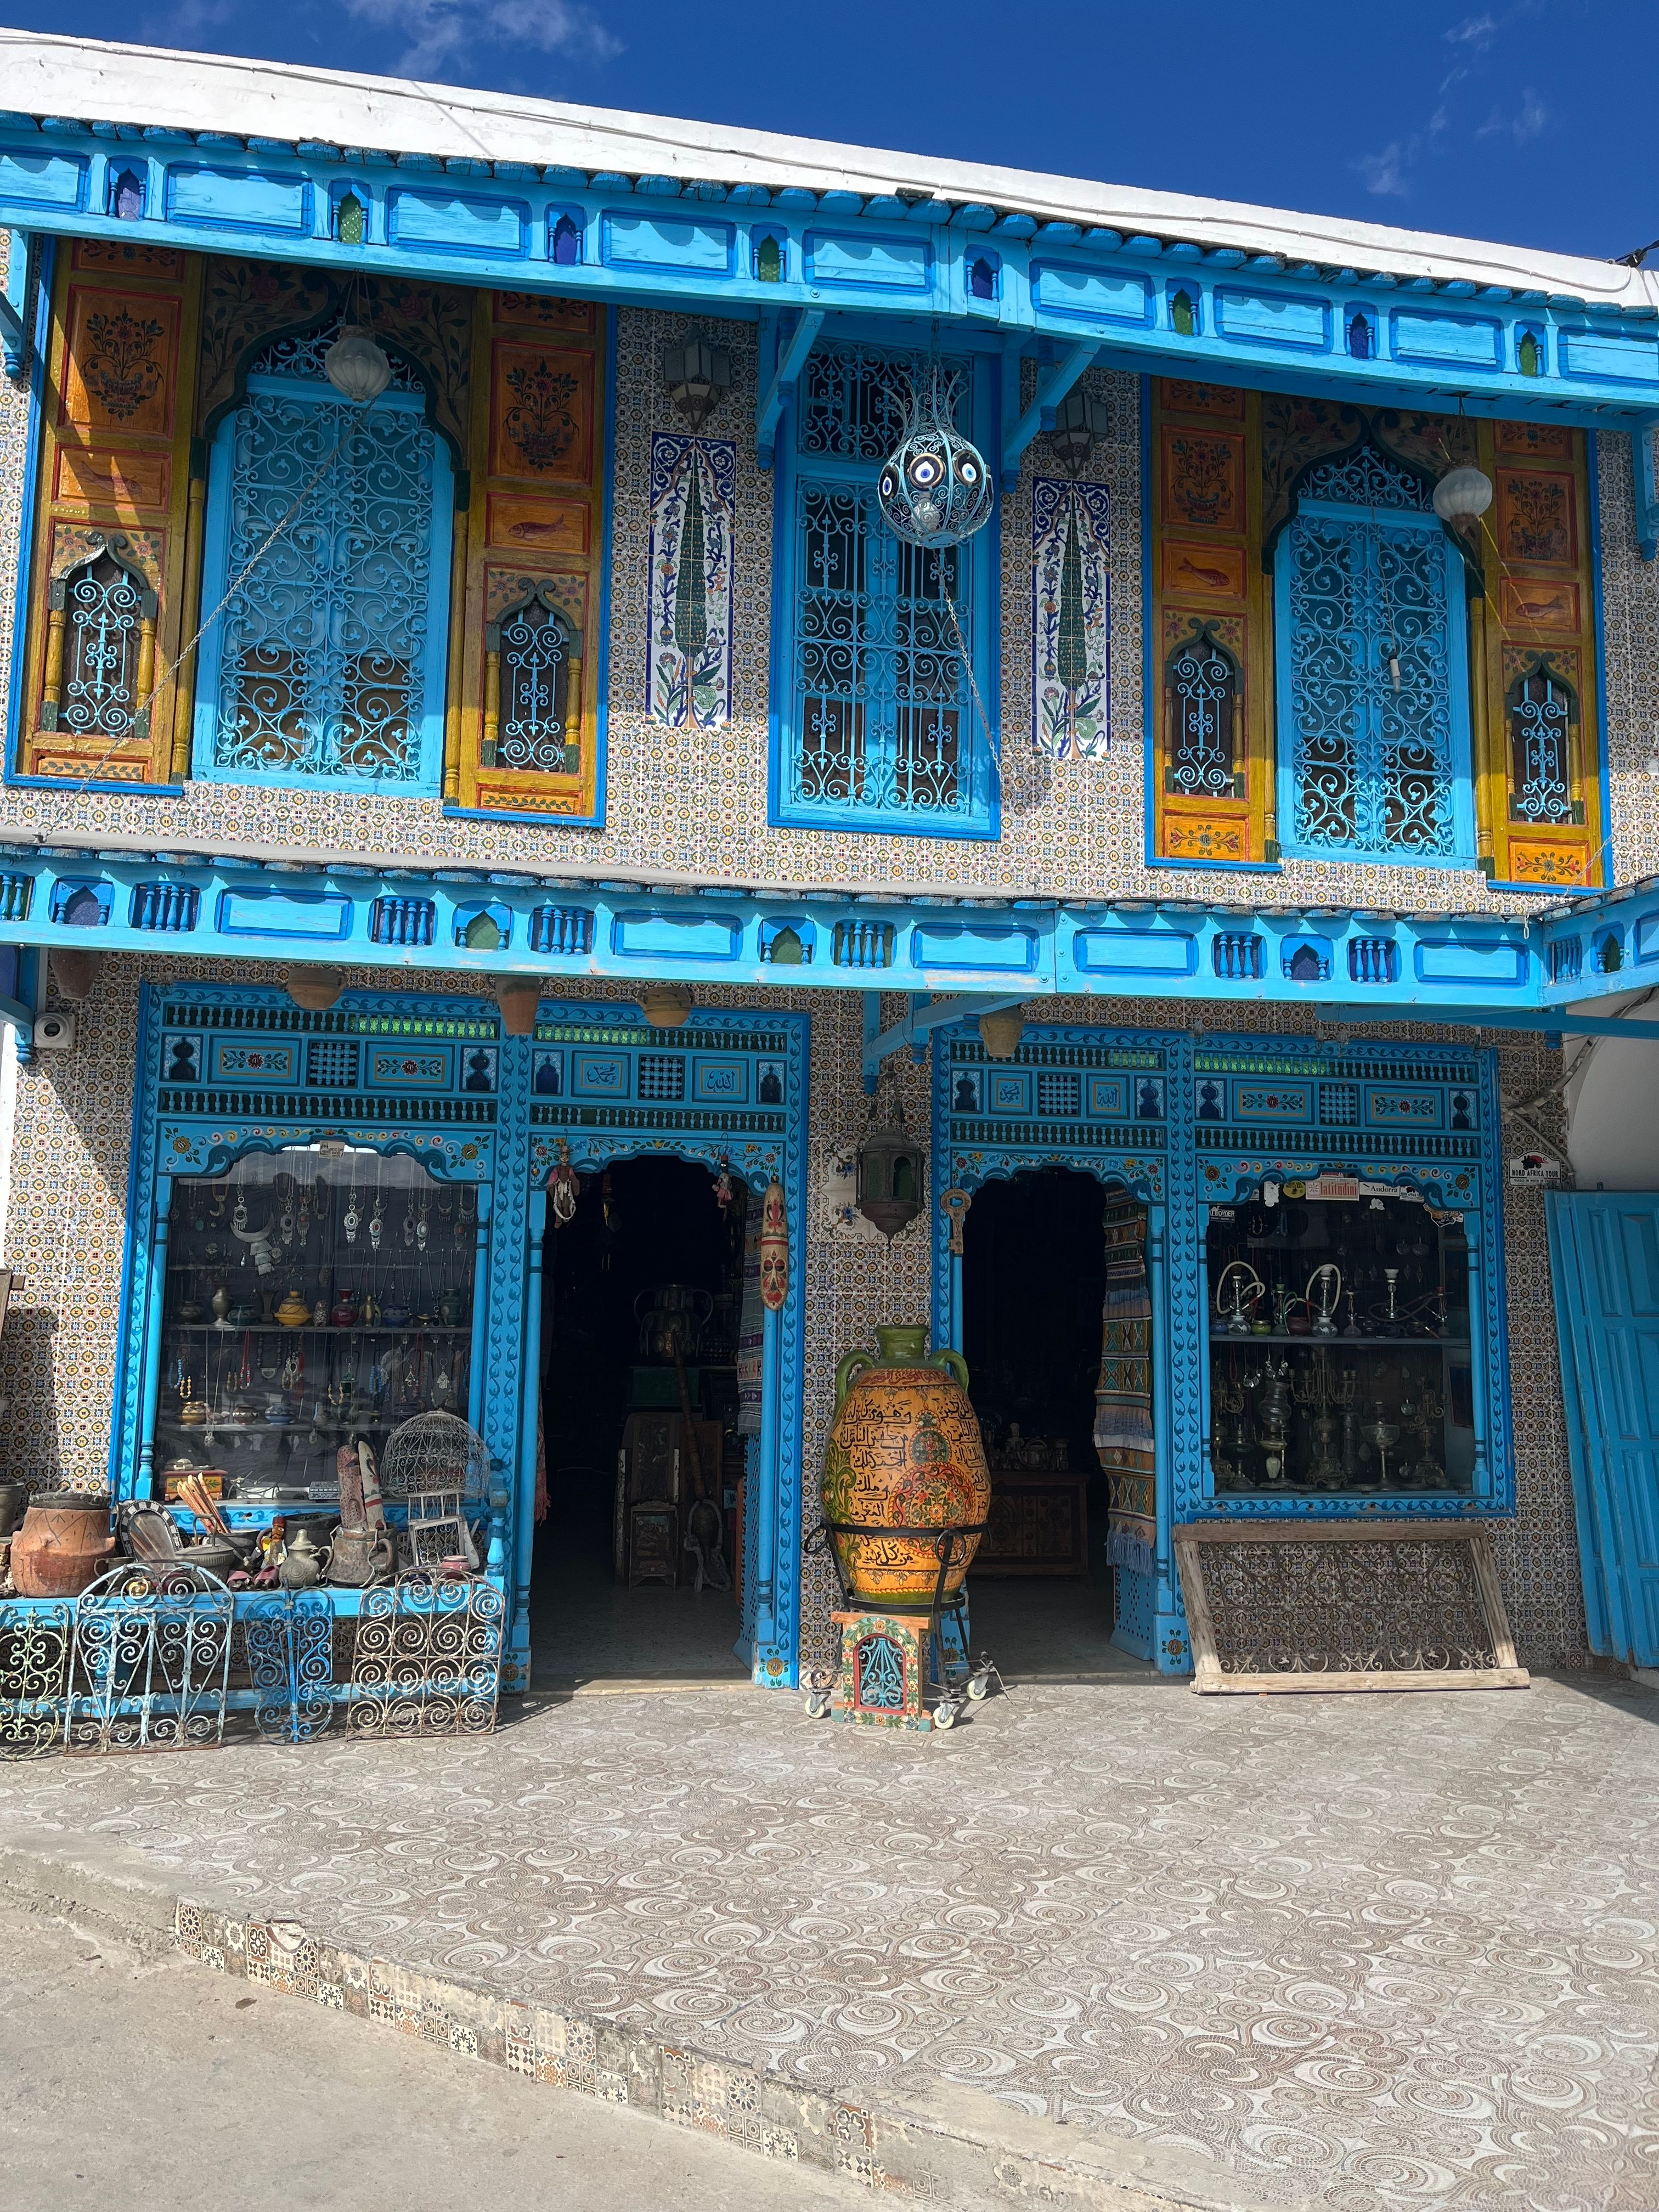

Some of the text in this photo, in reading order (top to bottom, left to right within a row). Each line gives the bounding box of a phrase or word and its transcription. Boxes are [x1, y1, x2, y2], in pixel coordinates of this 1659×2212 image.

[586, 1063, 617, 1085] محمد
[707, 1069, 735, 1093] الله
[999, 1082, 1021, 1104] محمد
[1097, 1086, 1118, 1108] الله
